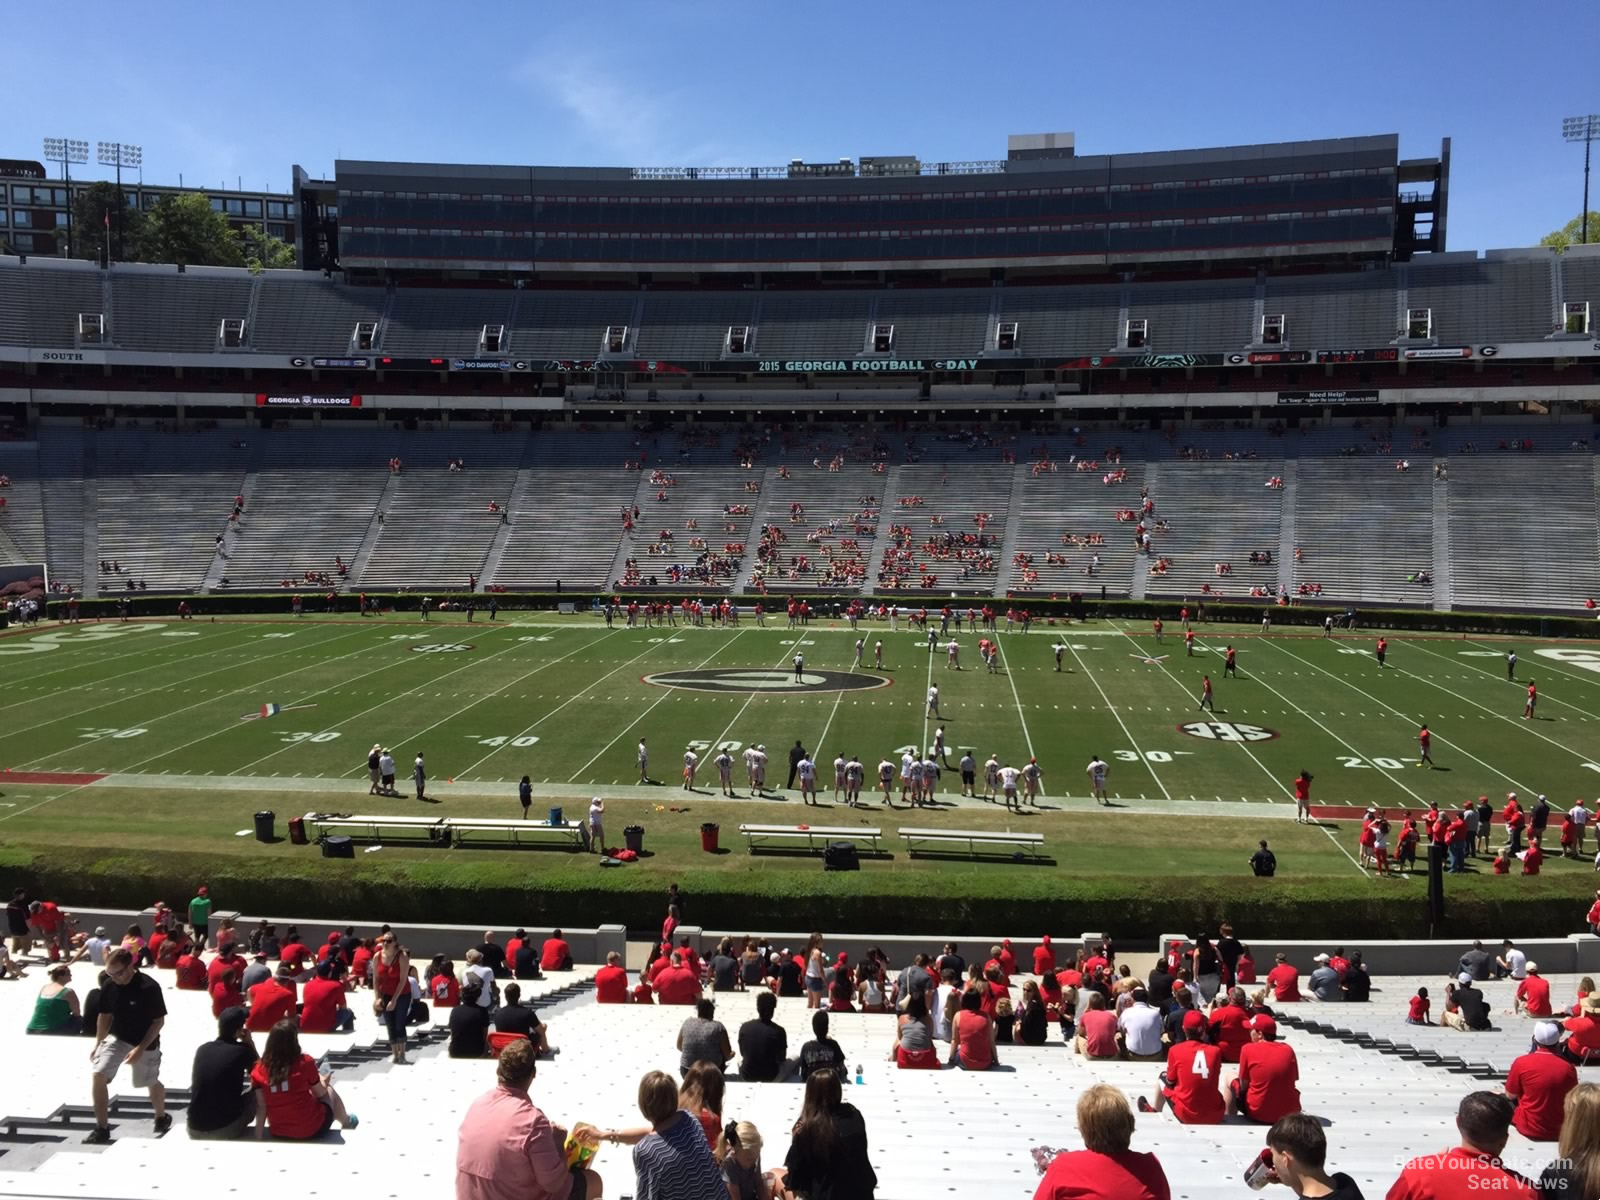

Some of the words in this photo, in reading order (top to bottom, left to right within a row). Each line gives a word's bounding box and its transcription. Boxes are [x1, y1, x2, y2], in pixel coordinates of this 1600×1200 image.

[43, 352, 83, 360] SOUTH
[759, 361, 780, 371] 2015
[785, 361, 847, 371] GEORGIA
[852, 360, 925, 371] FOOTBALL
[78, 729, 148, 739] 20
[280, 732, 342, 742] 30
[478, 736, 540, 747] 40
[686, 740, 743, 751] 50
[1113, 750, 1173, 762] 30
[1336, 756, 1405, 769] 20
[1192, 1050, 1209, 1079] 4
